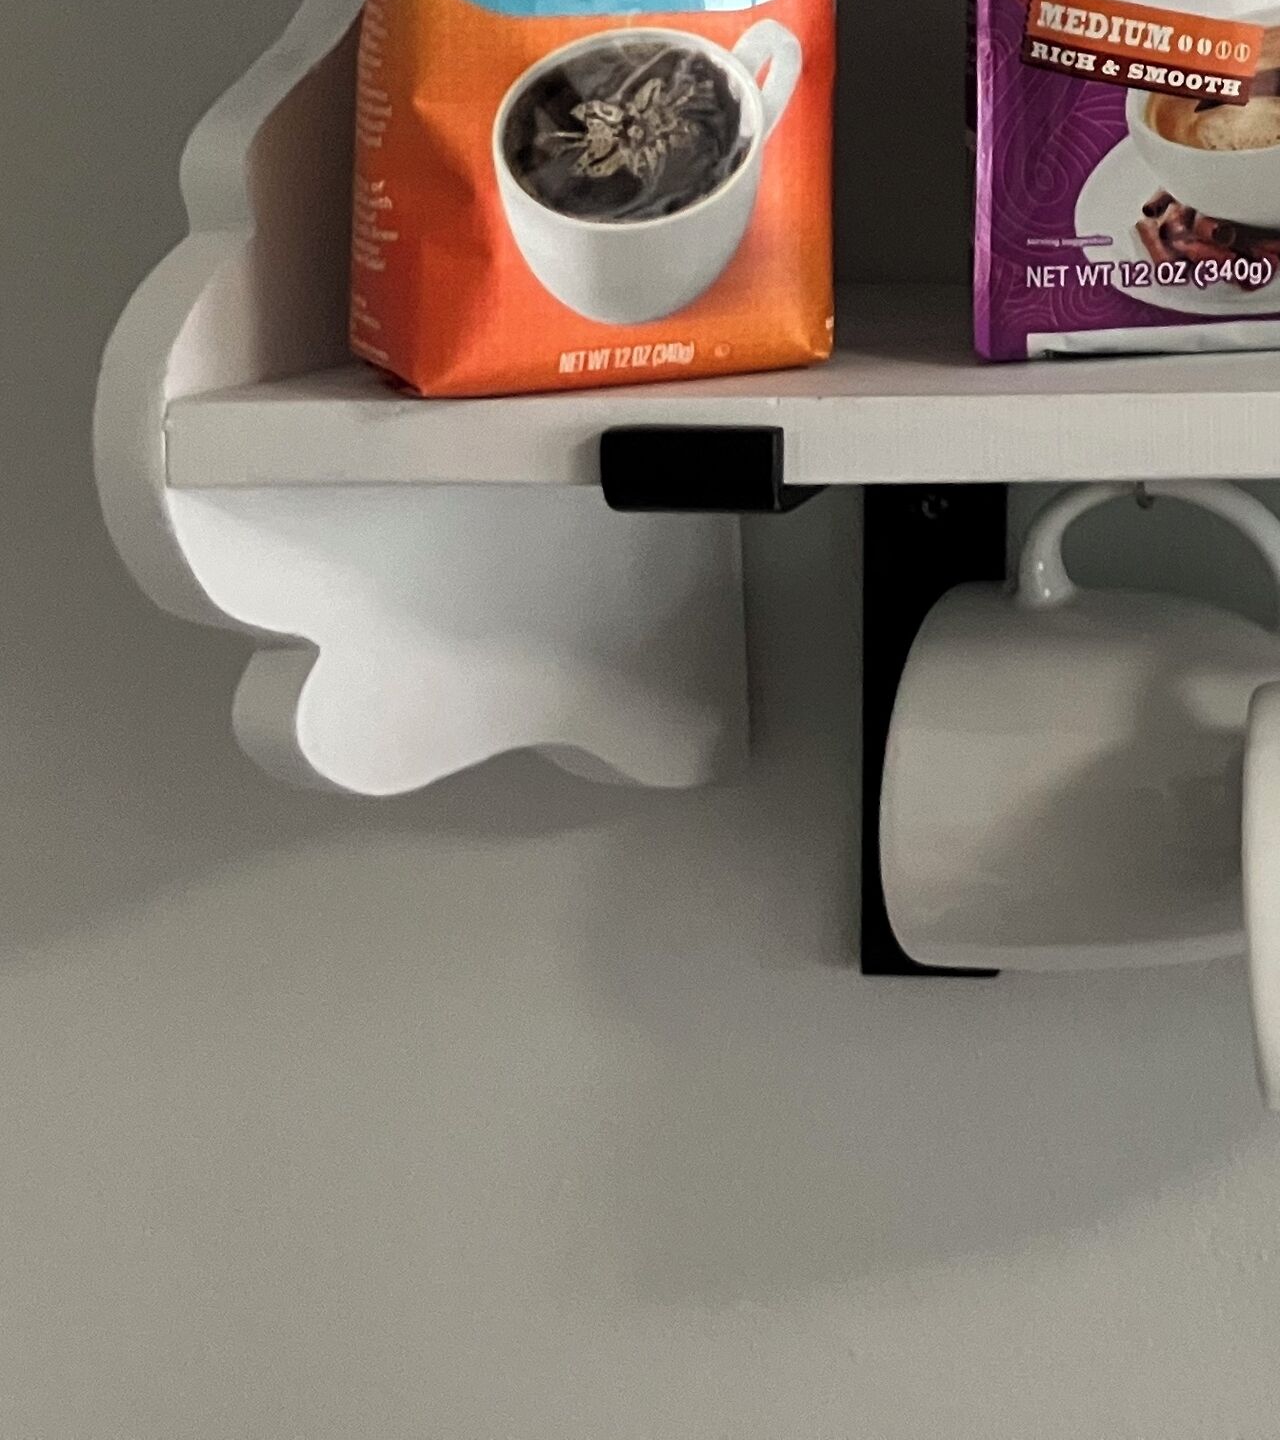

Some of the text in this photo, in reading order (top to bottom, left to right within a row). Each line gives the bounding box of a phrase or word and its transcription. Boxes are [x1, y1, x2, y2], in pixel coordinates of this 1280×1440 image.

[1036, 1, 1175, 52] MEDIUM
[1031, 42, 1242, 97] RICH & SMOOTH
[1026, 257, 1272, 289] NET WT 12 OZ (340g)
